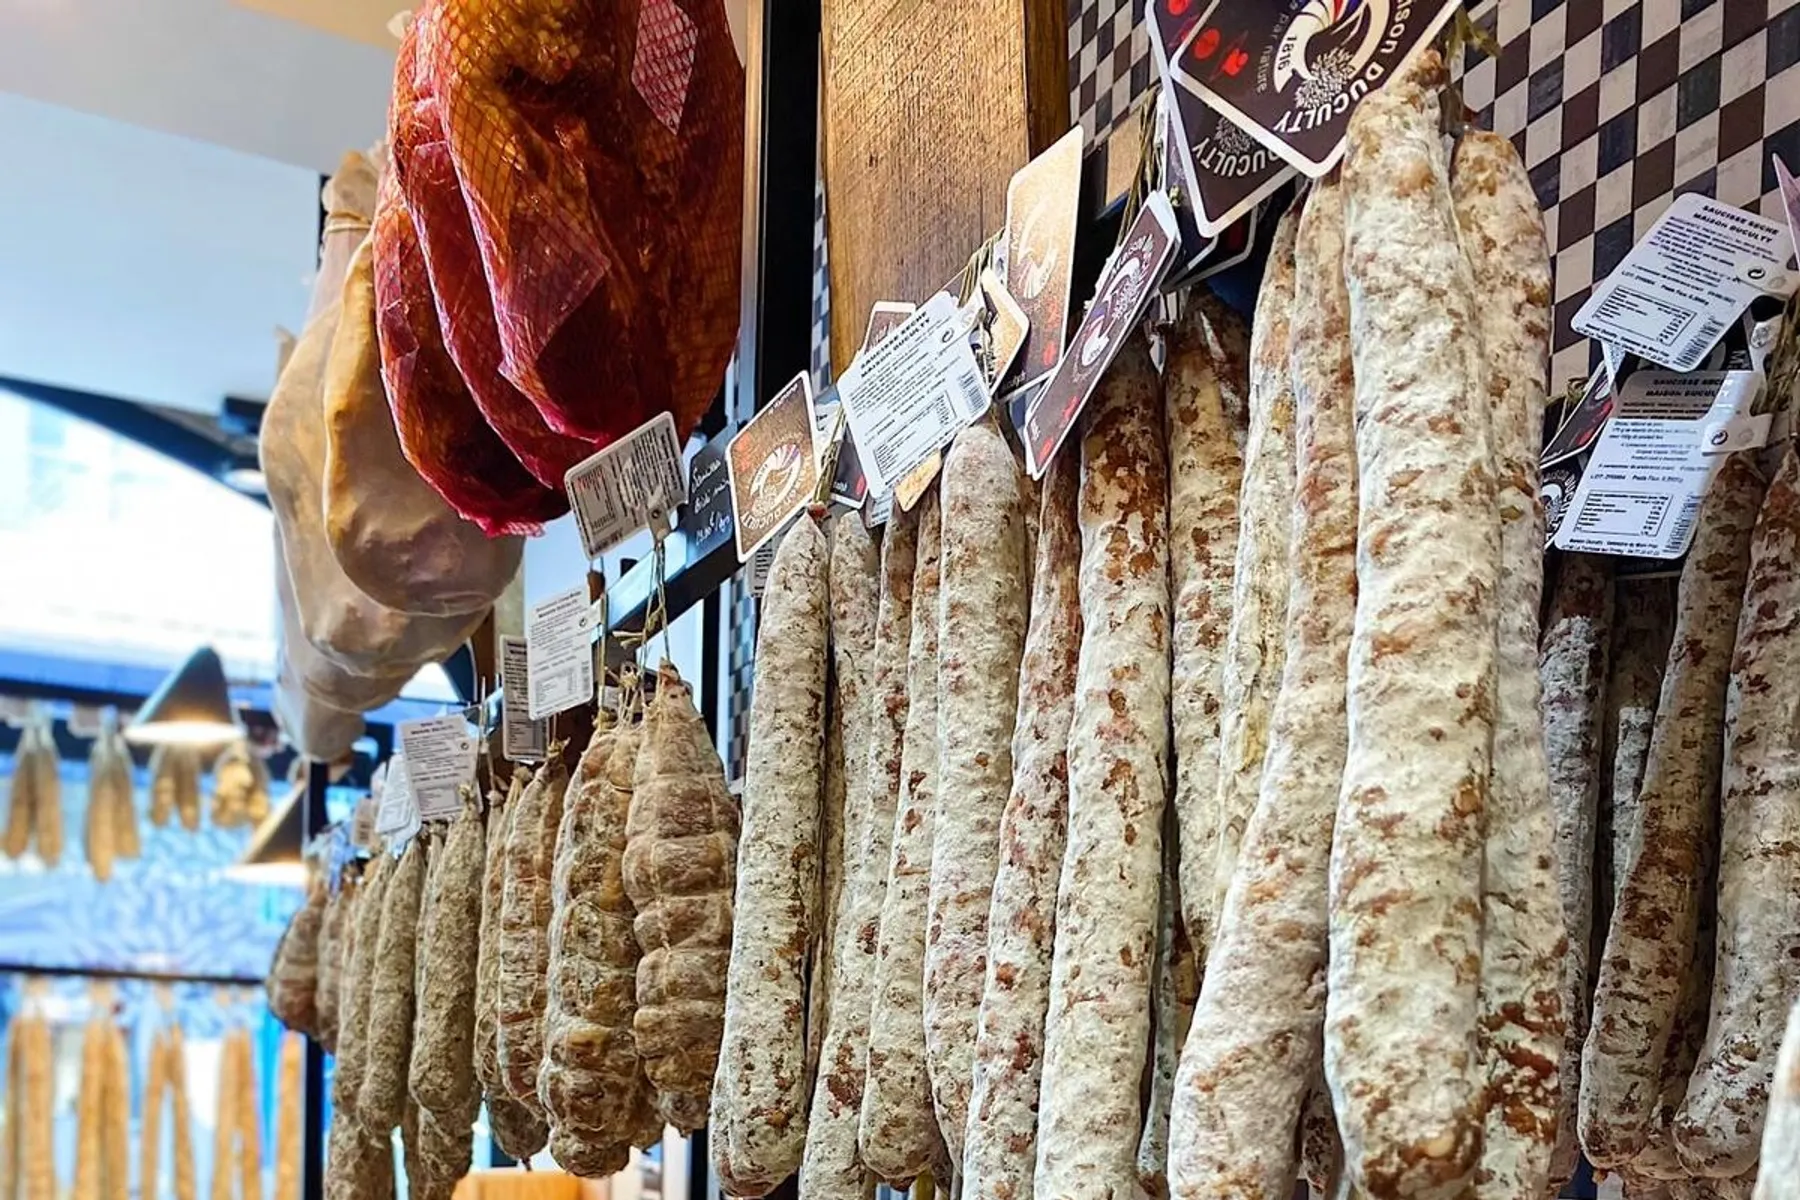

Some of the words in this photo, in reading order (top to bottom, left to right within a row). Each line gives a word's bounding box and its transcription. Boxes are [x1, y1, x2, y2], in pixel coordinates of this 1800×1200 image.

[1380, 0, 1413, 53] ison
[1256, 45, 1274, 94] nature
[1277, 35, 1297, 71] 1816
[1272, 61, 1385, 133] DUCULTY
[1693, 212, 1728, 228] MAISON
[1729, 225, 1773, 243] DUCULTY
[1702, 204, 1747, 224] SAUCISSE
[860, 350, 892, 378] MAISON
[1645, 389, 1682, 398] MAISON
